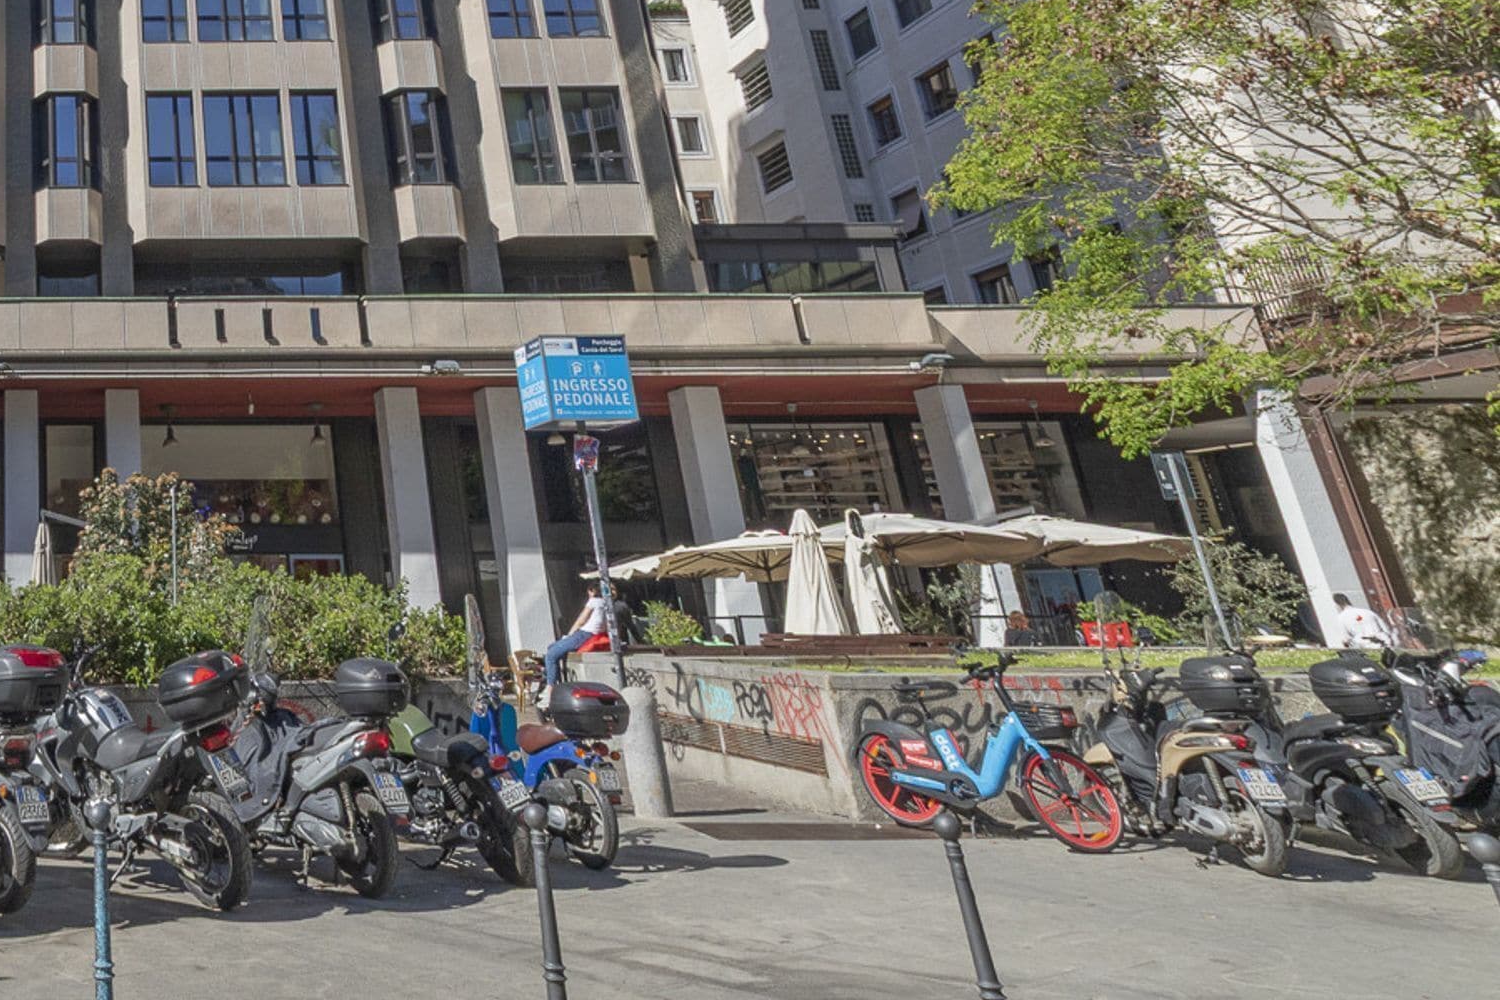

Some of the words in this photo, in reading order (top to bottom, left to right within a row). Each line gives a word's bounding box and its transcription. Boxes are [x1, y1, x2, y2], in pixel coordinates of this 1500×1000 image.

[552, 378, 628, 392] INGRESSO
[554, 392, 631, 406] PEDONALE
[934, 734, 961, 771] dott
